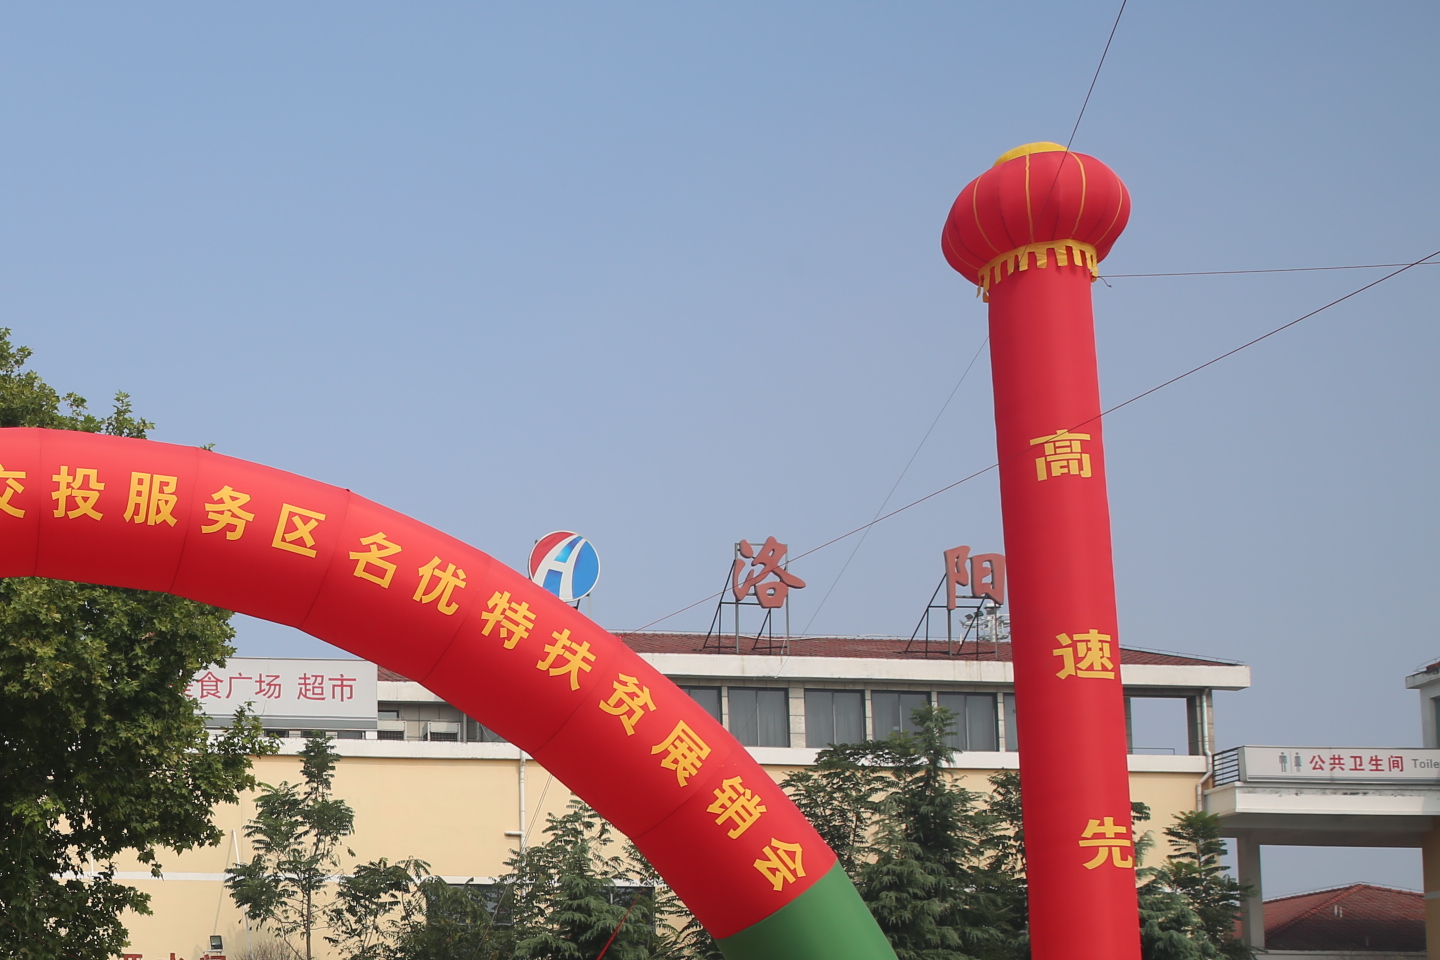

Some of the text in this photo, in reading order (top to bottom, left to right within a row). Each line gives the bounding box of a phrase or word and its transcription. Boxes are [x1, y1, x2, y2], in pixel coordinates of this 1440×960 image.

[733, 536, 1007, 611] 洛阳
[178, 671, 357, 702] 食广场 超市
[1309, 755, 1405, 773] 公共卫生间
